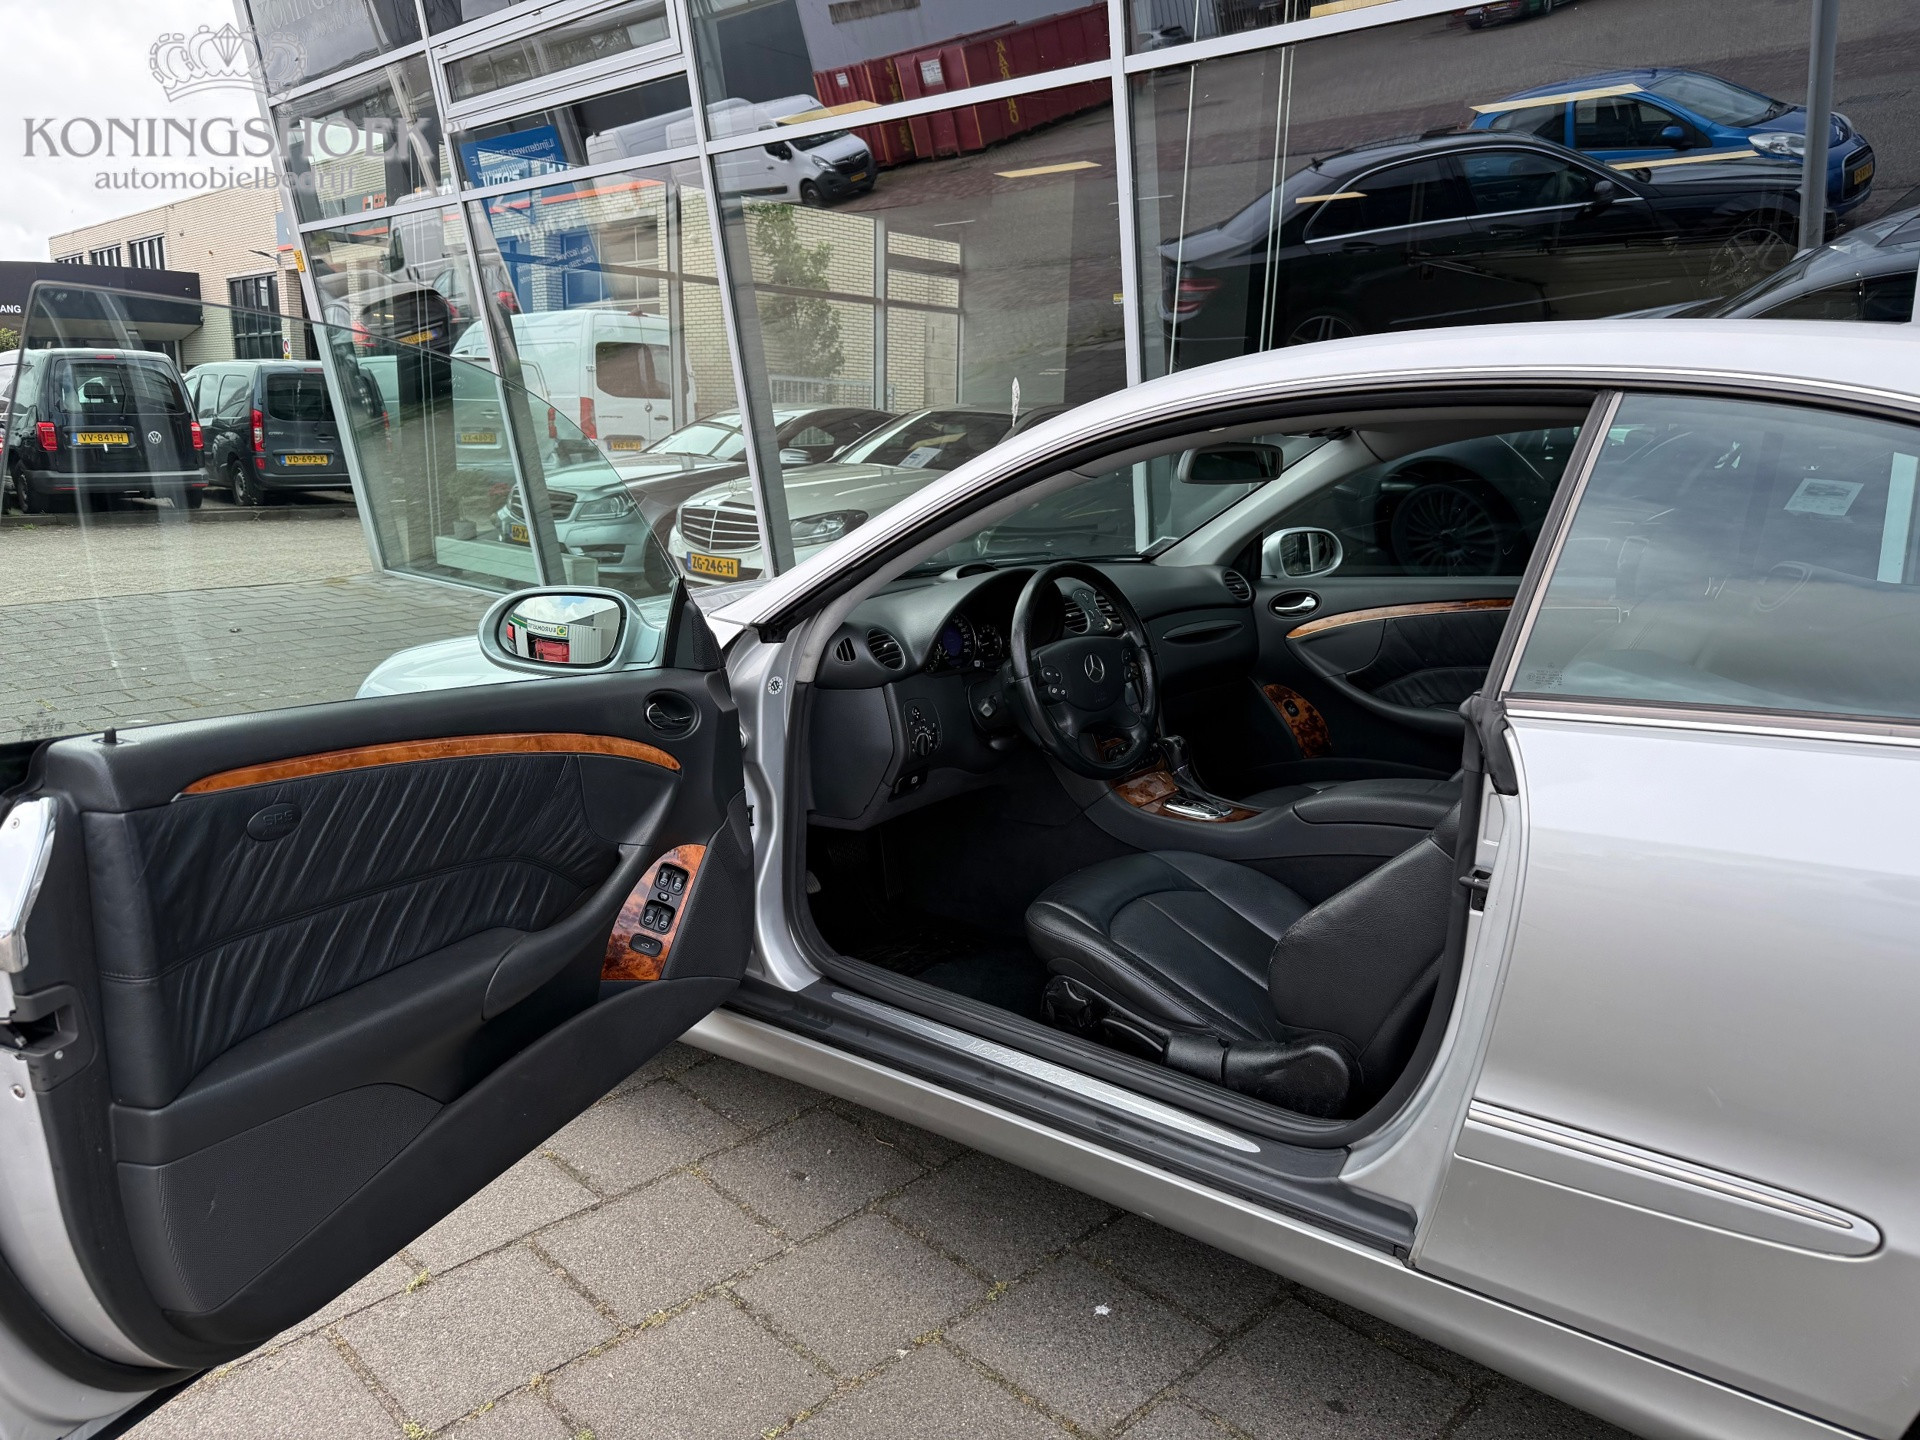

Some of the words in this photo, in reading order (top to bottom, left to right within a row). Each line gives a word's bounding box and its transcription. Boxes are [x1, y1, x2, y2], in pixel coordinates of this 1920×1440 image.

[80, 433, 124, 442] VV-841-H
[287, 455, 326, 463] VD-692-K
[692, 555, 735, 575] ZG-246-H
